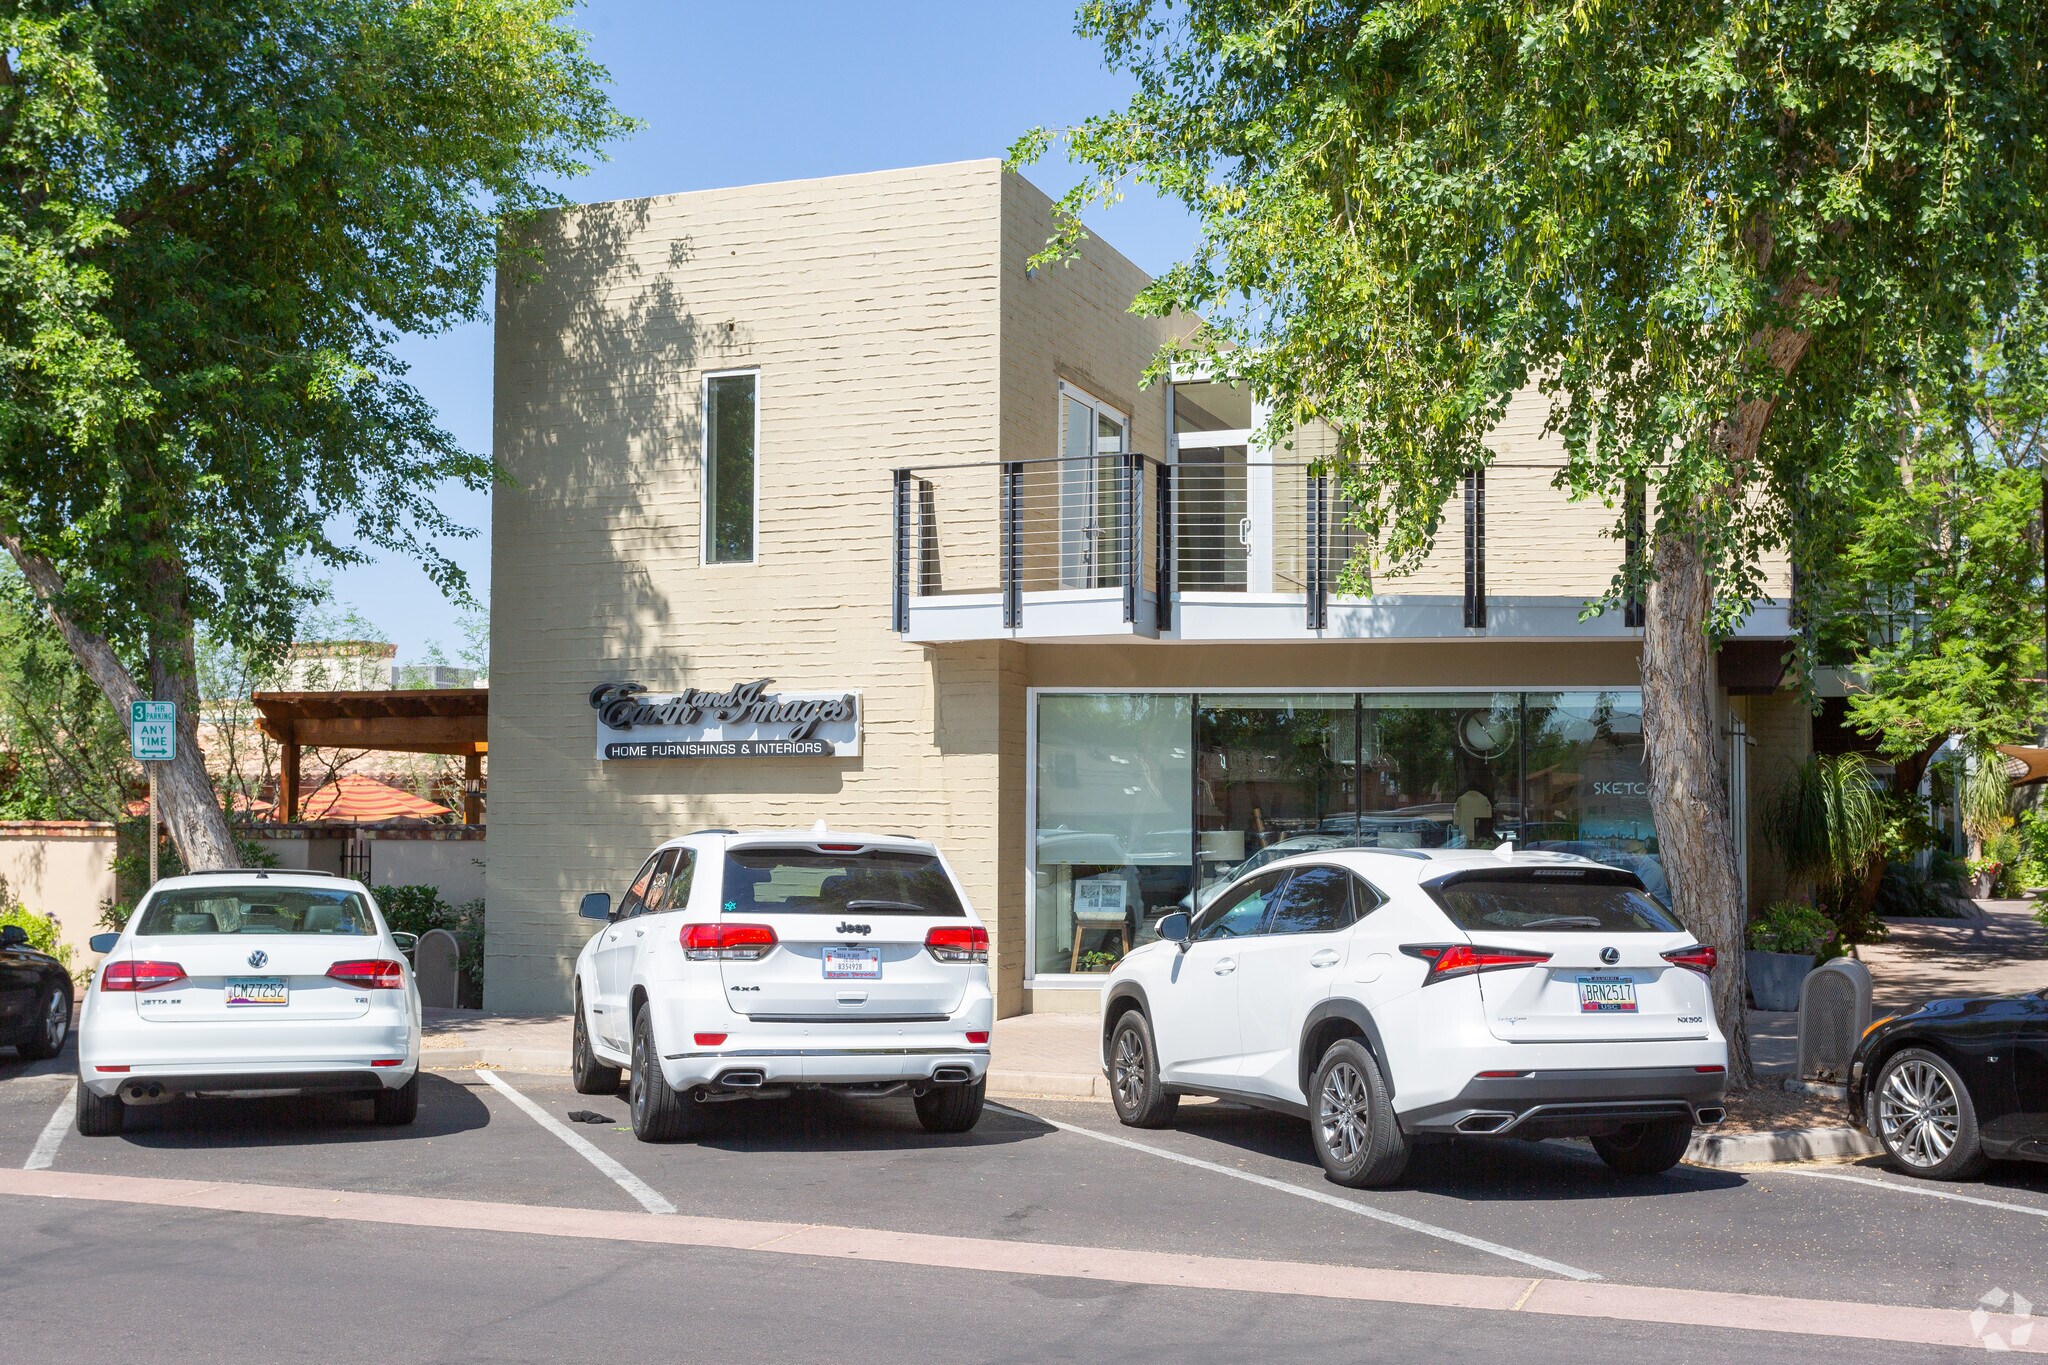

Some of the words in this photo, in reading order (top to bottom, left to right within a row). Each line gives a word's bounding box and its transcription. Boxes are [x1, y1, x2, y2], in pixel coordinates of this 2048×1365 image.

[691, 683, 741, 708] and
[135, 706, 143, 719] 3
[589, 683, 703, 730] Earth
[713, 677, 855, 743] Images
[146, 712, 173, 720] PARKING
[141, 726, 166, 734] ANY
[141, 737, 167, 746] TIME
[611, 745, 647, 757] HOME
[652, 743, 736, 756] FURNISHINGS
[741, 743, 751, 755] &
[755, 742, 822, 755] INTERIORS
[1593, 781, 1646, 795] SKETC
[836, 921, 872, 936] Jeep
[233, 983, 285, 998] CMZ7252
[1585, 984, 1631, 1001] BRN2517
